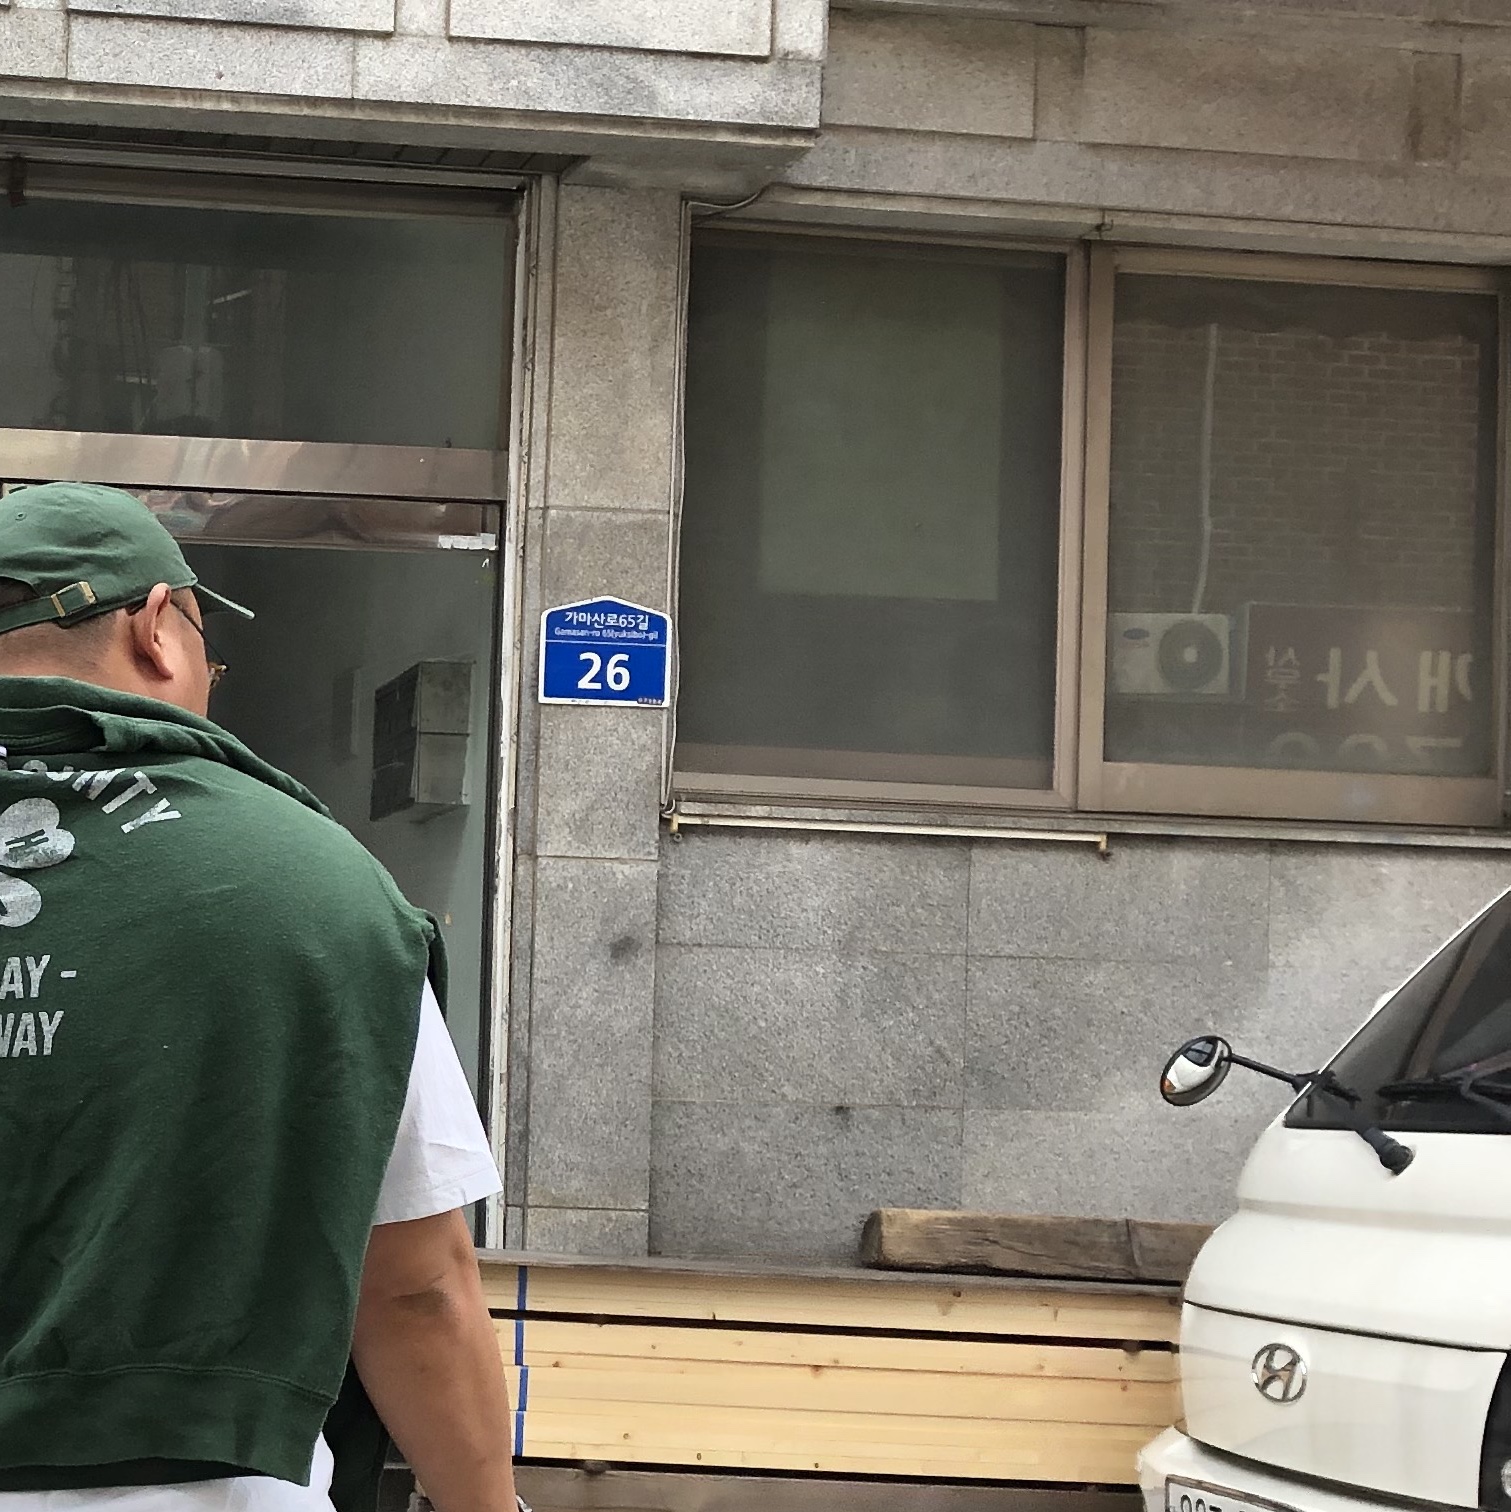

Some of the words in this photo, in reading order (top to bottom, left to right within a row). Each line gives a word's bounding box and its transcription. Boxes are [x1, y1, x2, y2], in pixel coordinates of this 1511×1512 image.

[565, 612, 649, 630] 가마산로65길
[577, 652, 630, 691] 26
[5, 829, 49, 848] H
